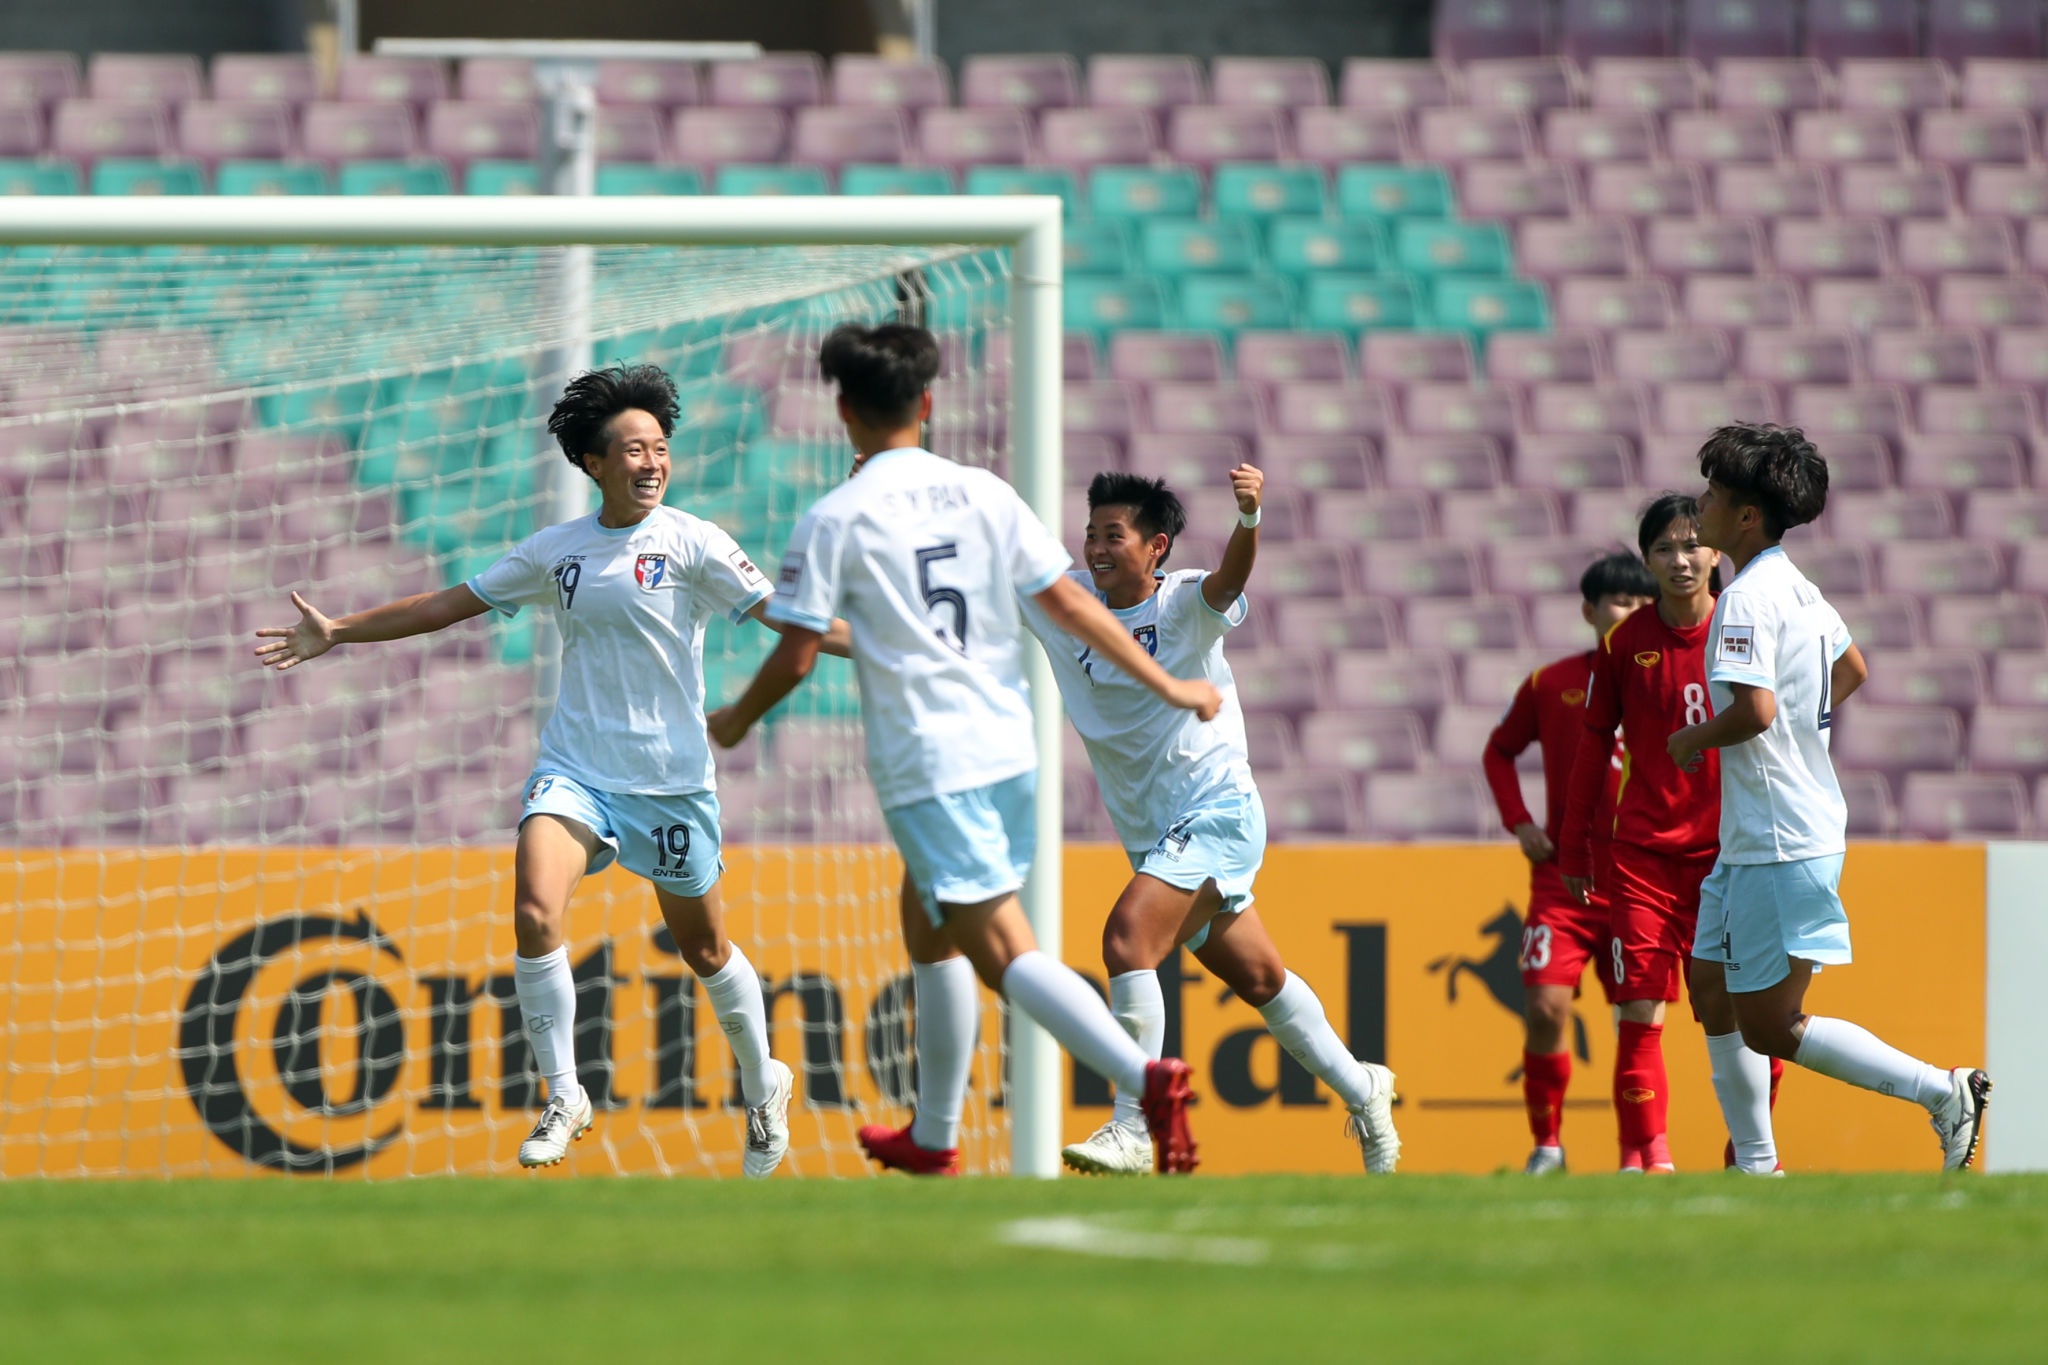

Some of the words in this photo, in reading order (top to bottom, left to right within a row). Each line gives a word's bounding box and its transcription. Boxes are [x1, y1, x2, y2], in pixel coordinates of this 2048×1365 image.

[554, 562, 582, 611] 19
[914, 542, 969, 655] 5
[1683, 682, 1708, 726] 8
[651, 824, 690, 869] 19
[652, 868, 691, 879] ENTES
[1521, 922, 1553, 972] 23
[1611, 935, 1626, 985] 8
